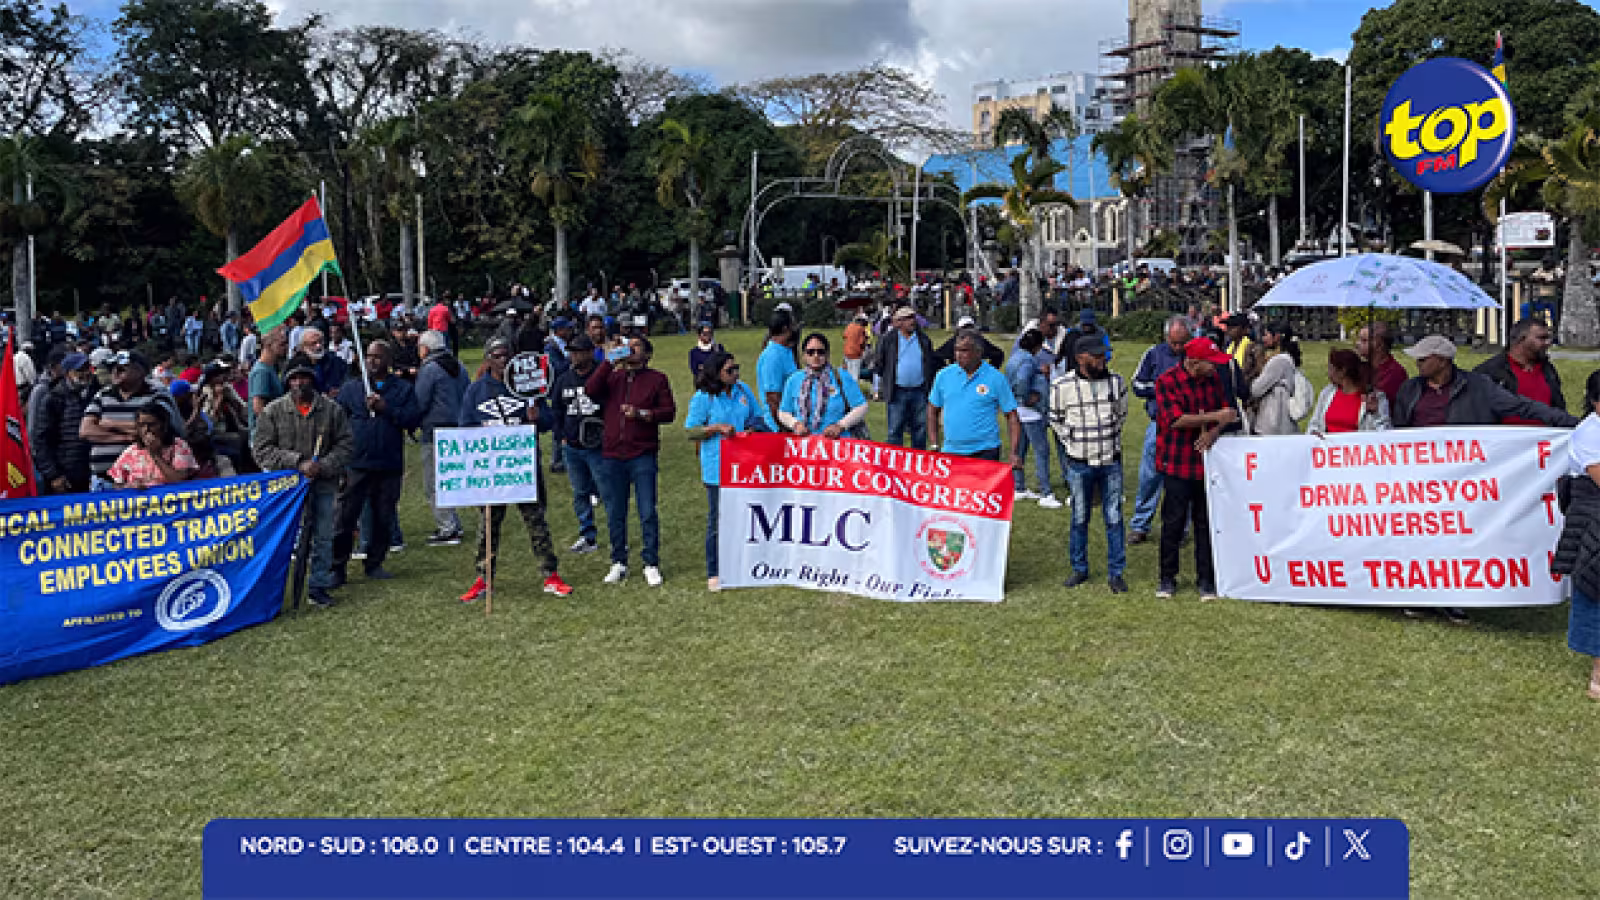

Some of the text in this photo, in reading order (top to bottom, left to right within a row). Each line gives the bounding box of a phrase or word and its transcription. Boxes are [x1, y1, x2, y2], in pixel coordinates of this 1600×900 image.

[437, 439, 461, 458] PA
[784, 436, 952, 479] MAURITIUS
[1311, 439, 1487, 470] DEMANTELMA
[63, 480, 262, 527] MANUFACTURING
[730, 462, 1003, 515] LABOUR CONGRESS
[1299, 477, 1500, 509] DRWA PANSYON
[19, 507, 259, 565] CONNECTED TRADES
[747, 502, 872, 552] MLC
[1327, 510, 1474, 538] UNIVERSEL
[40, 536, 255, 595] EMPLOYEES UNION
[751, 561, 792, 580] Our
[799, 564, 850, 588] Right
[865, 573, 905, 594] Our
[1286, 557, 1531, 589] ENE TRAHIZON
